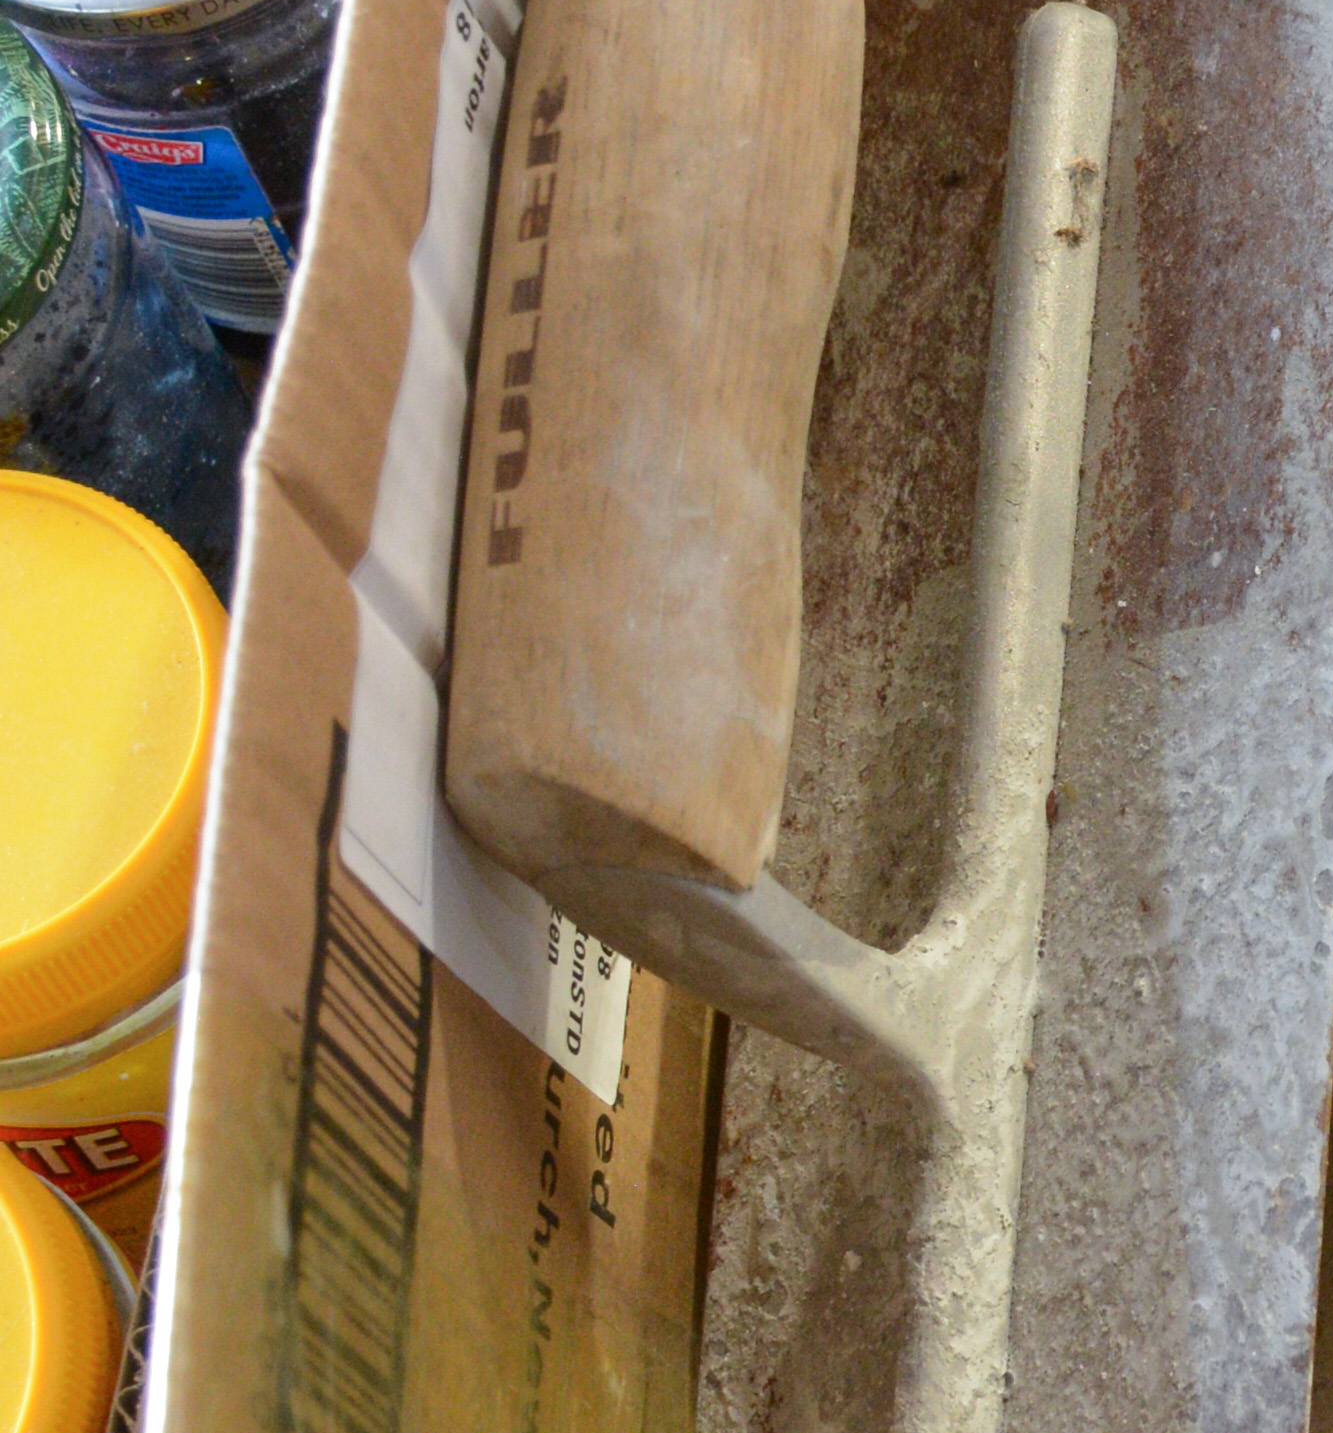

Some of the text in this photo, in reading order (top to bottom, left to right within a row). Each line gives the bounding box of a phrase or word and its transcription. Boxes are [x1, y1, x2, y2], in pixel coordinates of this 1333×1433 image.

[113, 8, 191, 33] EVERY
[464, 28, 492, 134] arton
[96, 133, 197, 165] Craig's
[35, 246, 66, 292] Open
[60, 209, 78, 242] the
[486, 74, 569, 567] FULLER
